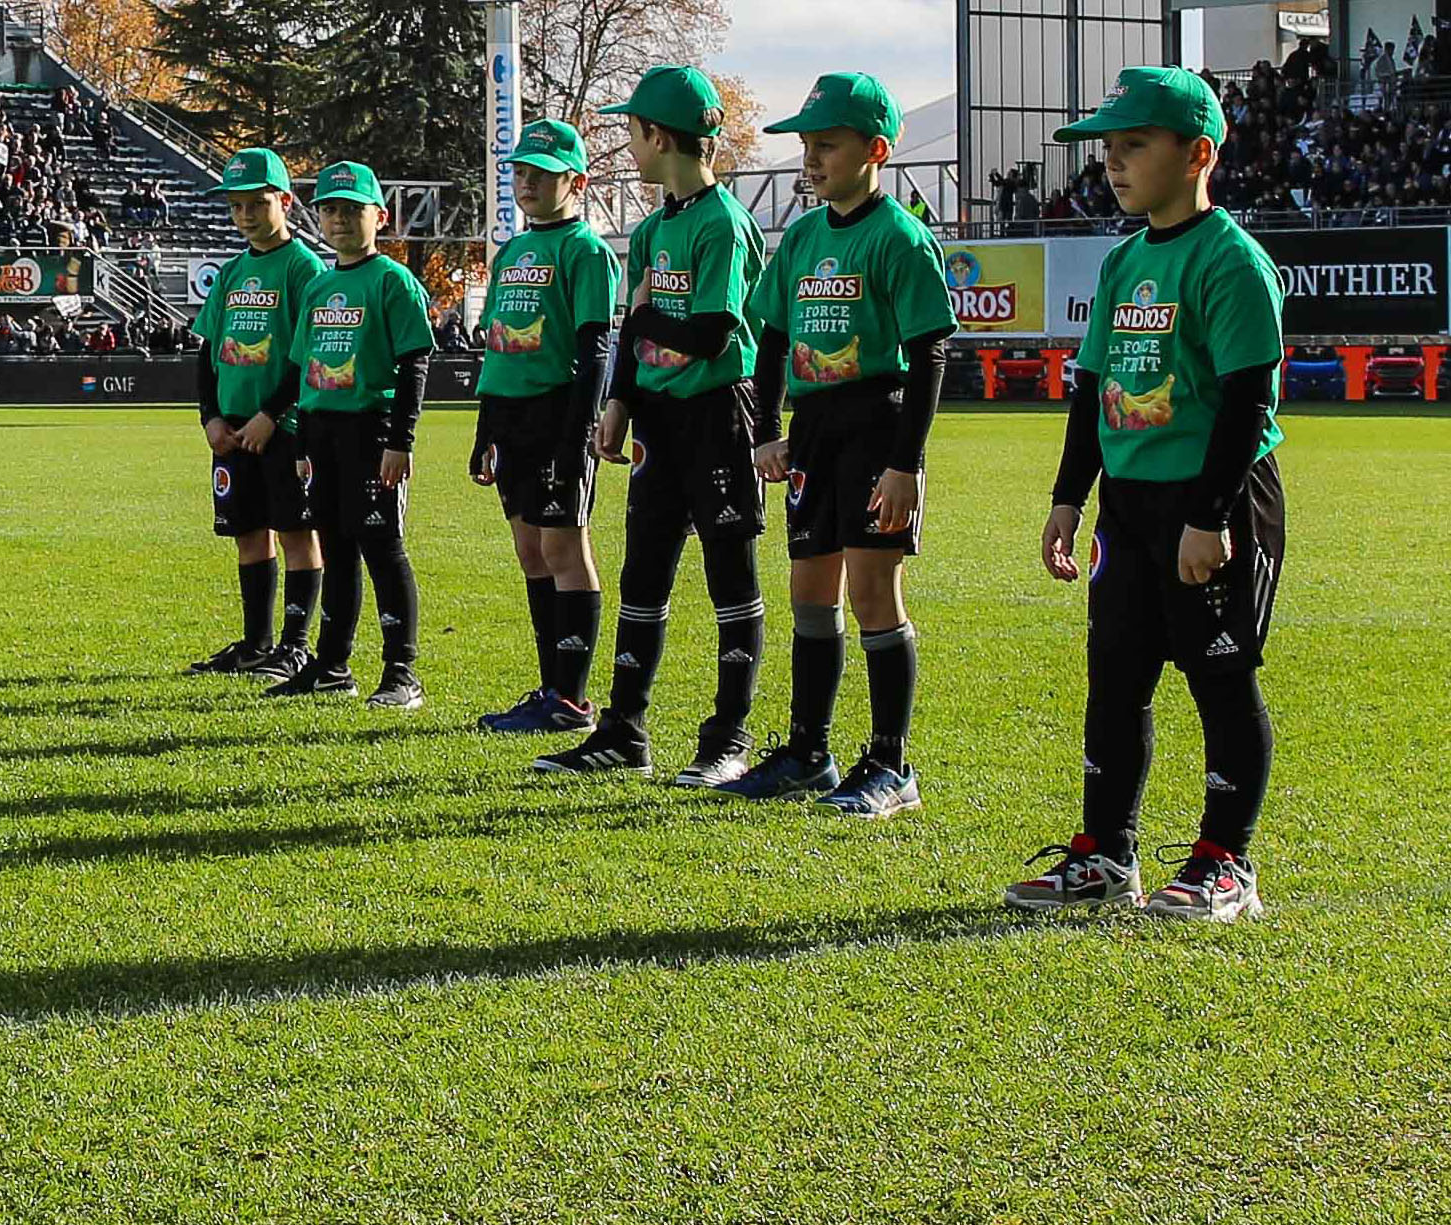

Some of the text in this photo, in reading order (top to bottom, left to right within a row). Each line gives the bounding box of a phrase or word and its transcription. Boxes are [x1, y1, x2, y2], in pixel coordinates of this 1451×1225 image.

[490, 89, 514, 246] Carrefour
[797, 279, 856, 297] ANDROS
[227, 293, 275, 306] ANDROS
[312, 310, 361, 324] ANDROS
[805, 305, 851, 319] FORCE
[231, 321, 268, 332] FRUIT
[803, 319, 850, 334] FRUIT
[1122, 339, 1160, 355] FOCE
[102, 376, 136, 394] GMF
